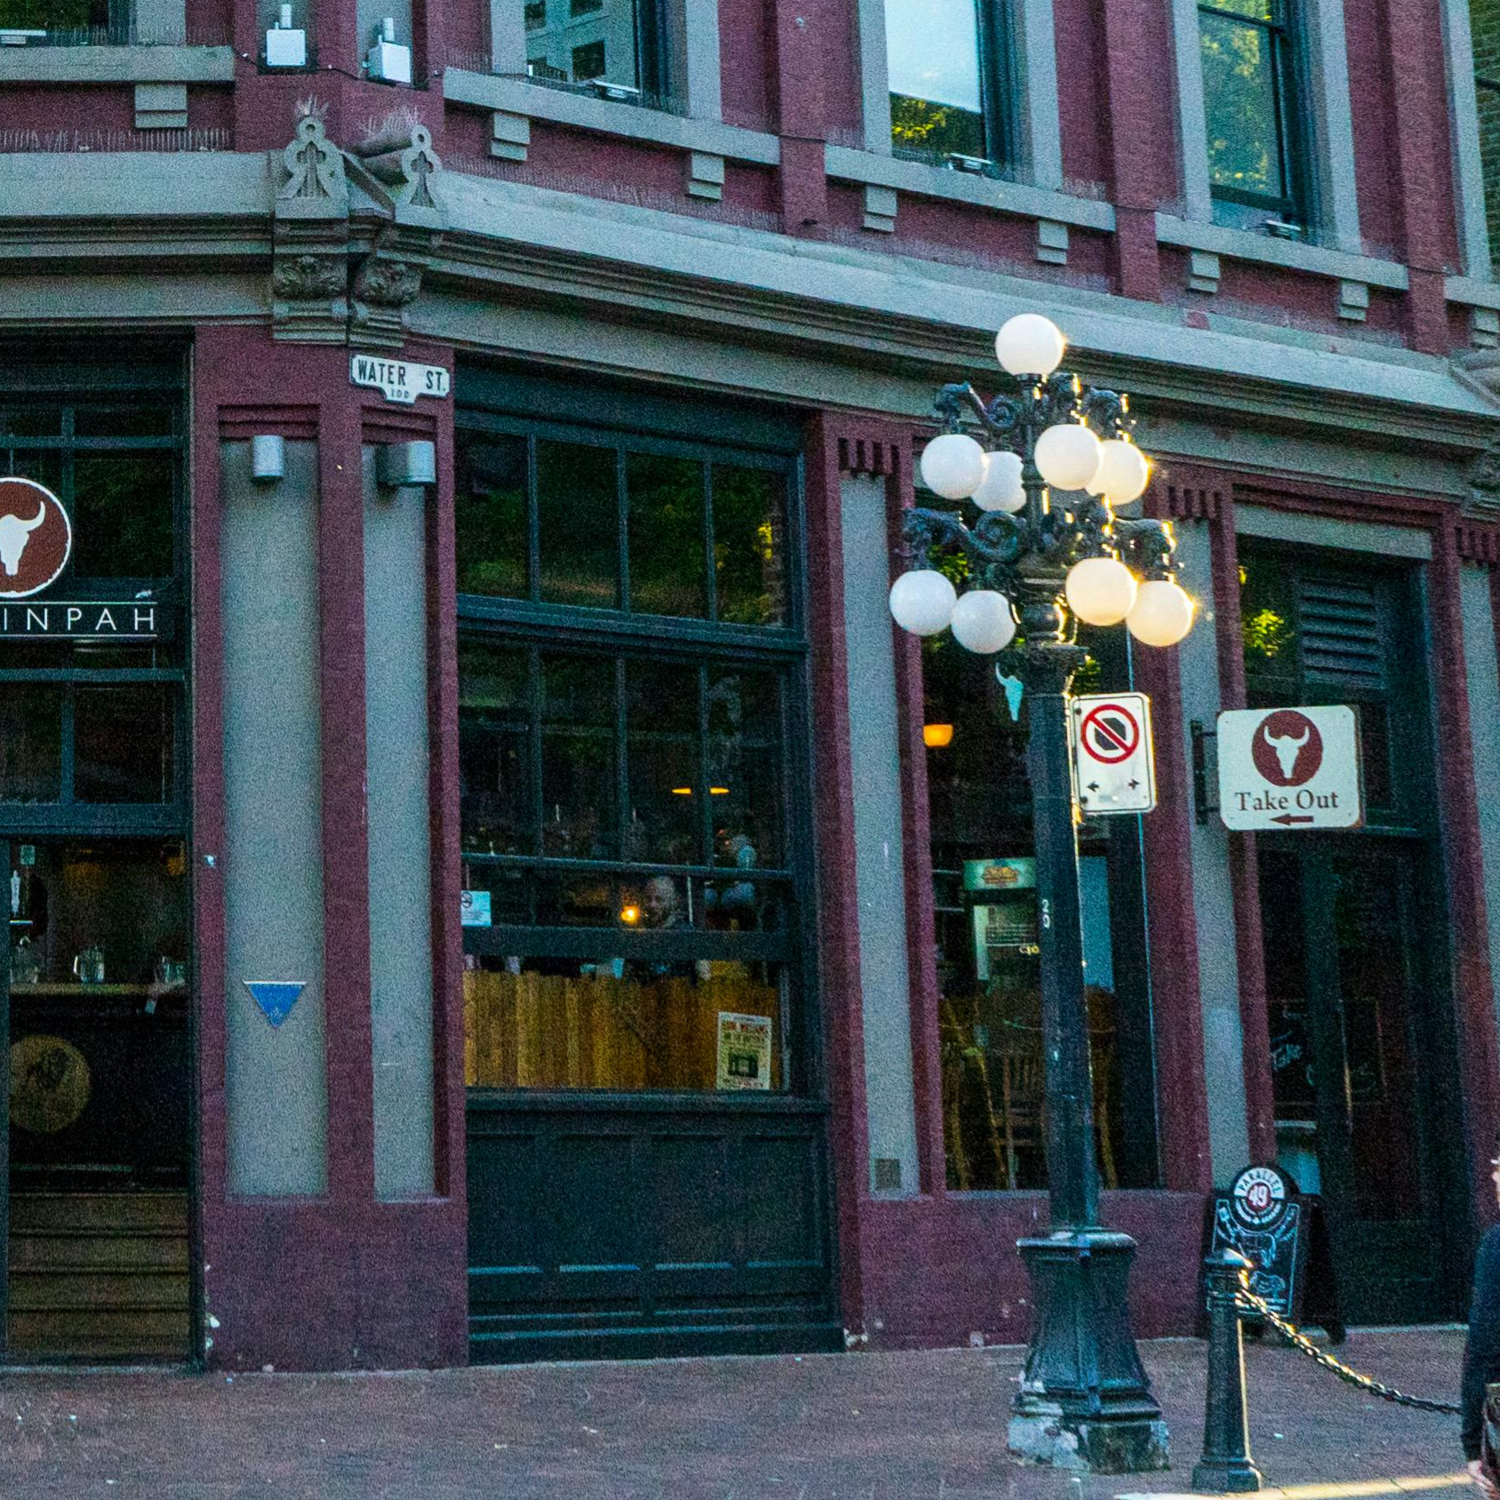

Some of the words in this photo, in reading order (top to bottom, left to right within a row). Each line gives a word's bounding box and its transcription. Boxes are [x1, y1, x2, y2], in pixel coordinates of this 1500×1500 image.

[357, 359, 407, 387] WATER
[425, 369, 447, 392] ST.
[1234, 790, 1289, 812] Take
[1296, 789, 1339, 810] Out
[1237, 1169, 1283, 1194] PARALLEL
[1249, 1185, 1268, 1208] 49
